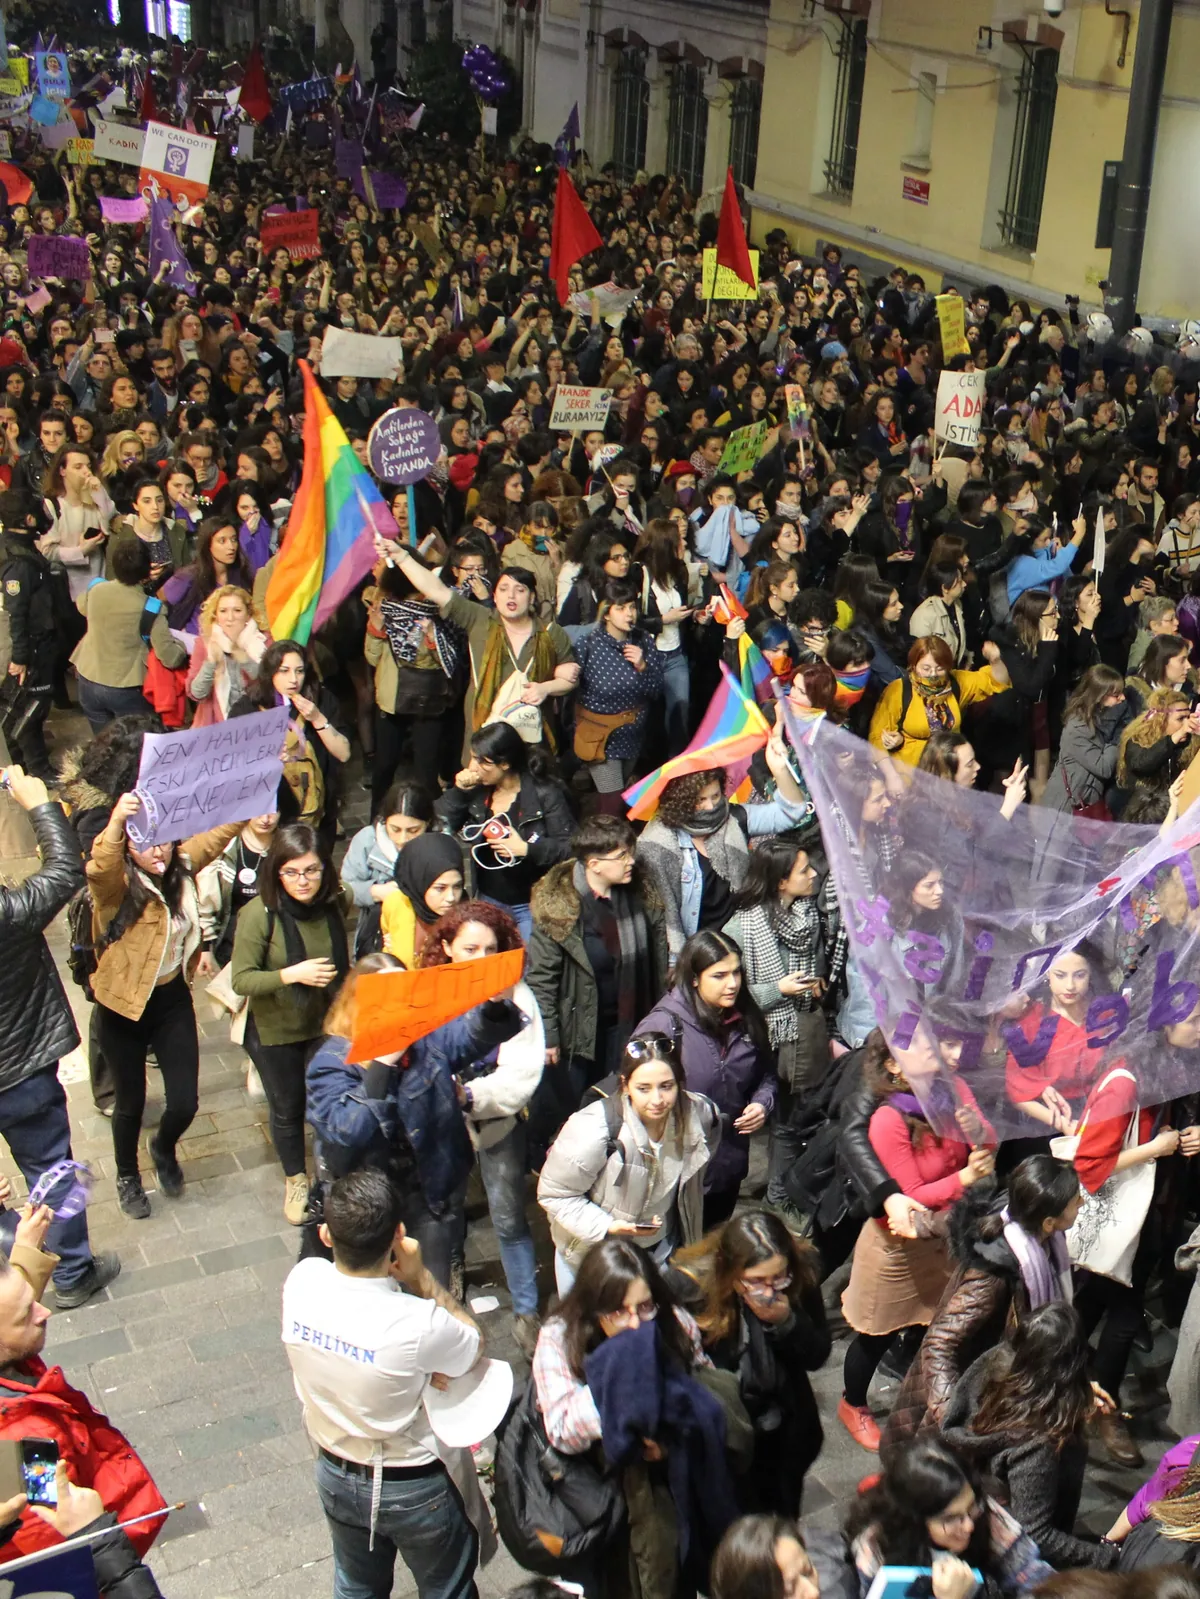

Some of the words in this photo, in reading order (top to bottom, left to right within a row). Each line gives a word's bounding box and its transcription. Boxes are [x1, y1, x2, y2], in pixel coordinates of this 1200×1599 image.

[151, 128, 164, 137] WE
[167, 132, 185, 144] CAN
[187, 137, 200, 148] DO
[559, 387, 592, 398] HANDE
[552, 411, 607, 424] BURADAYIZ
[292, 1320, 377, 1365] PEHLİVAN
